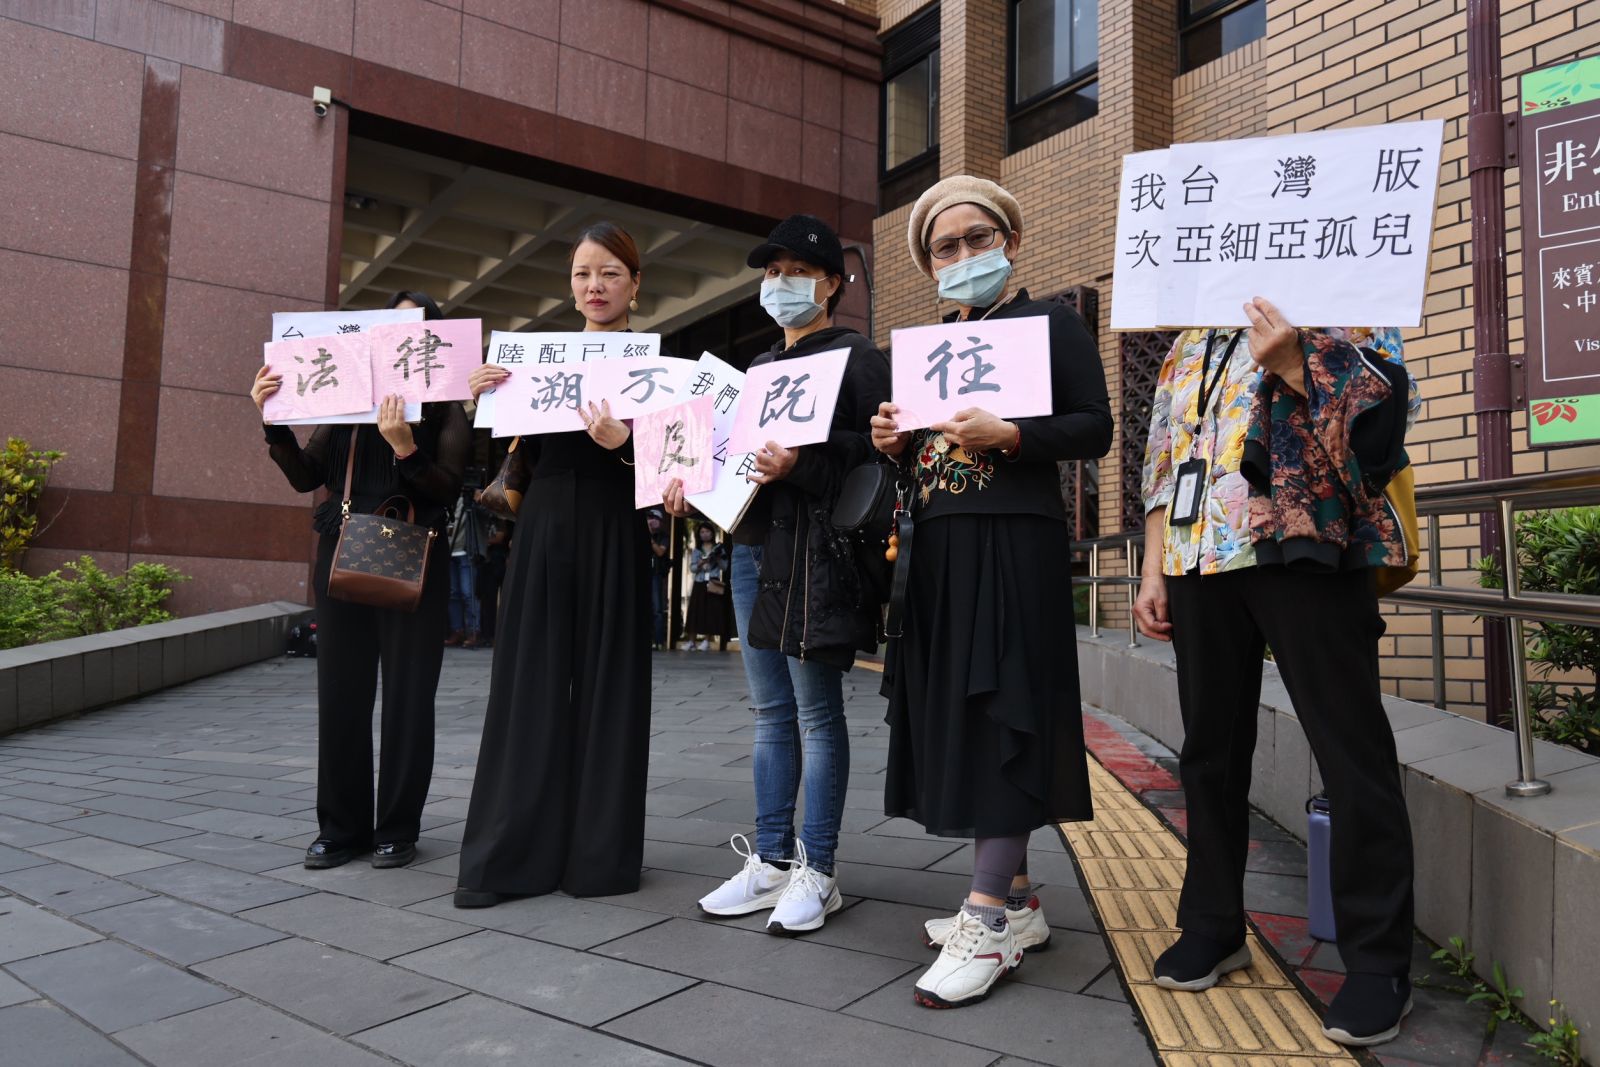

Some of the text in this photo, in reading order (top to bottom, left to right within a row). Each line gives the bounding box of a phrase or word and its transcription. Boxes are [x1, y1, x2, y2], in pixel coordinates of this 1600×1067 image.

[1181, 146, 1424, 206] 台灣版
[1173, 212, 1413, 263] 亞細亞孤兒
[1552, 261, 1600, 290] 來賓
[294, 347, 339, 397] 法
[393, 329, 453, 389] 律
[924, 336, 1001, 400] 往
[530, 371, 584, 412] 溯
[620, 367, 675, 404] 不
[690, 371, 740, 415] 我們
[759, 373, 817, 428] 既
[657, 420, 699, 475] 及
